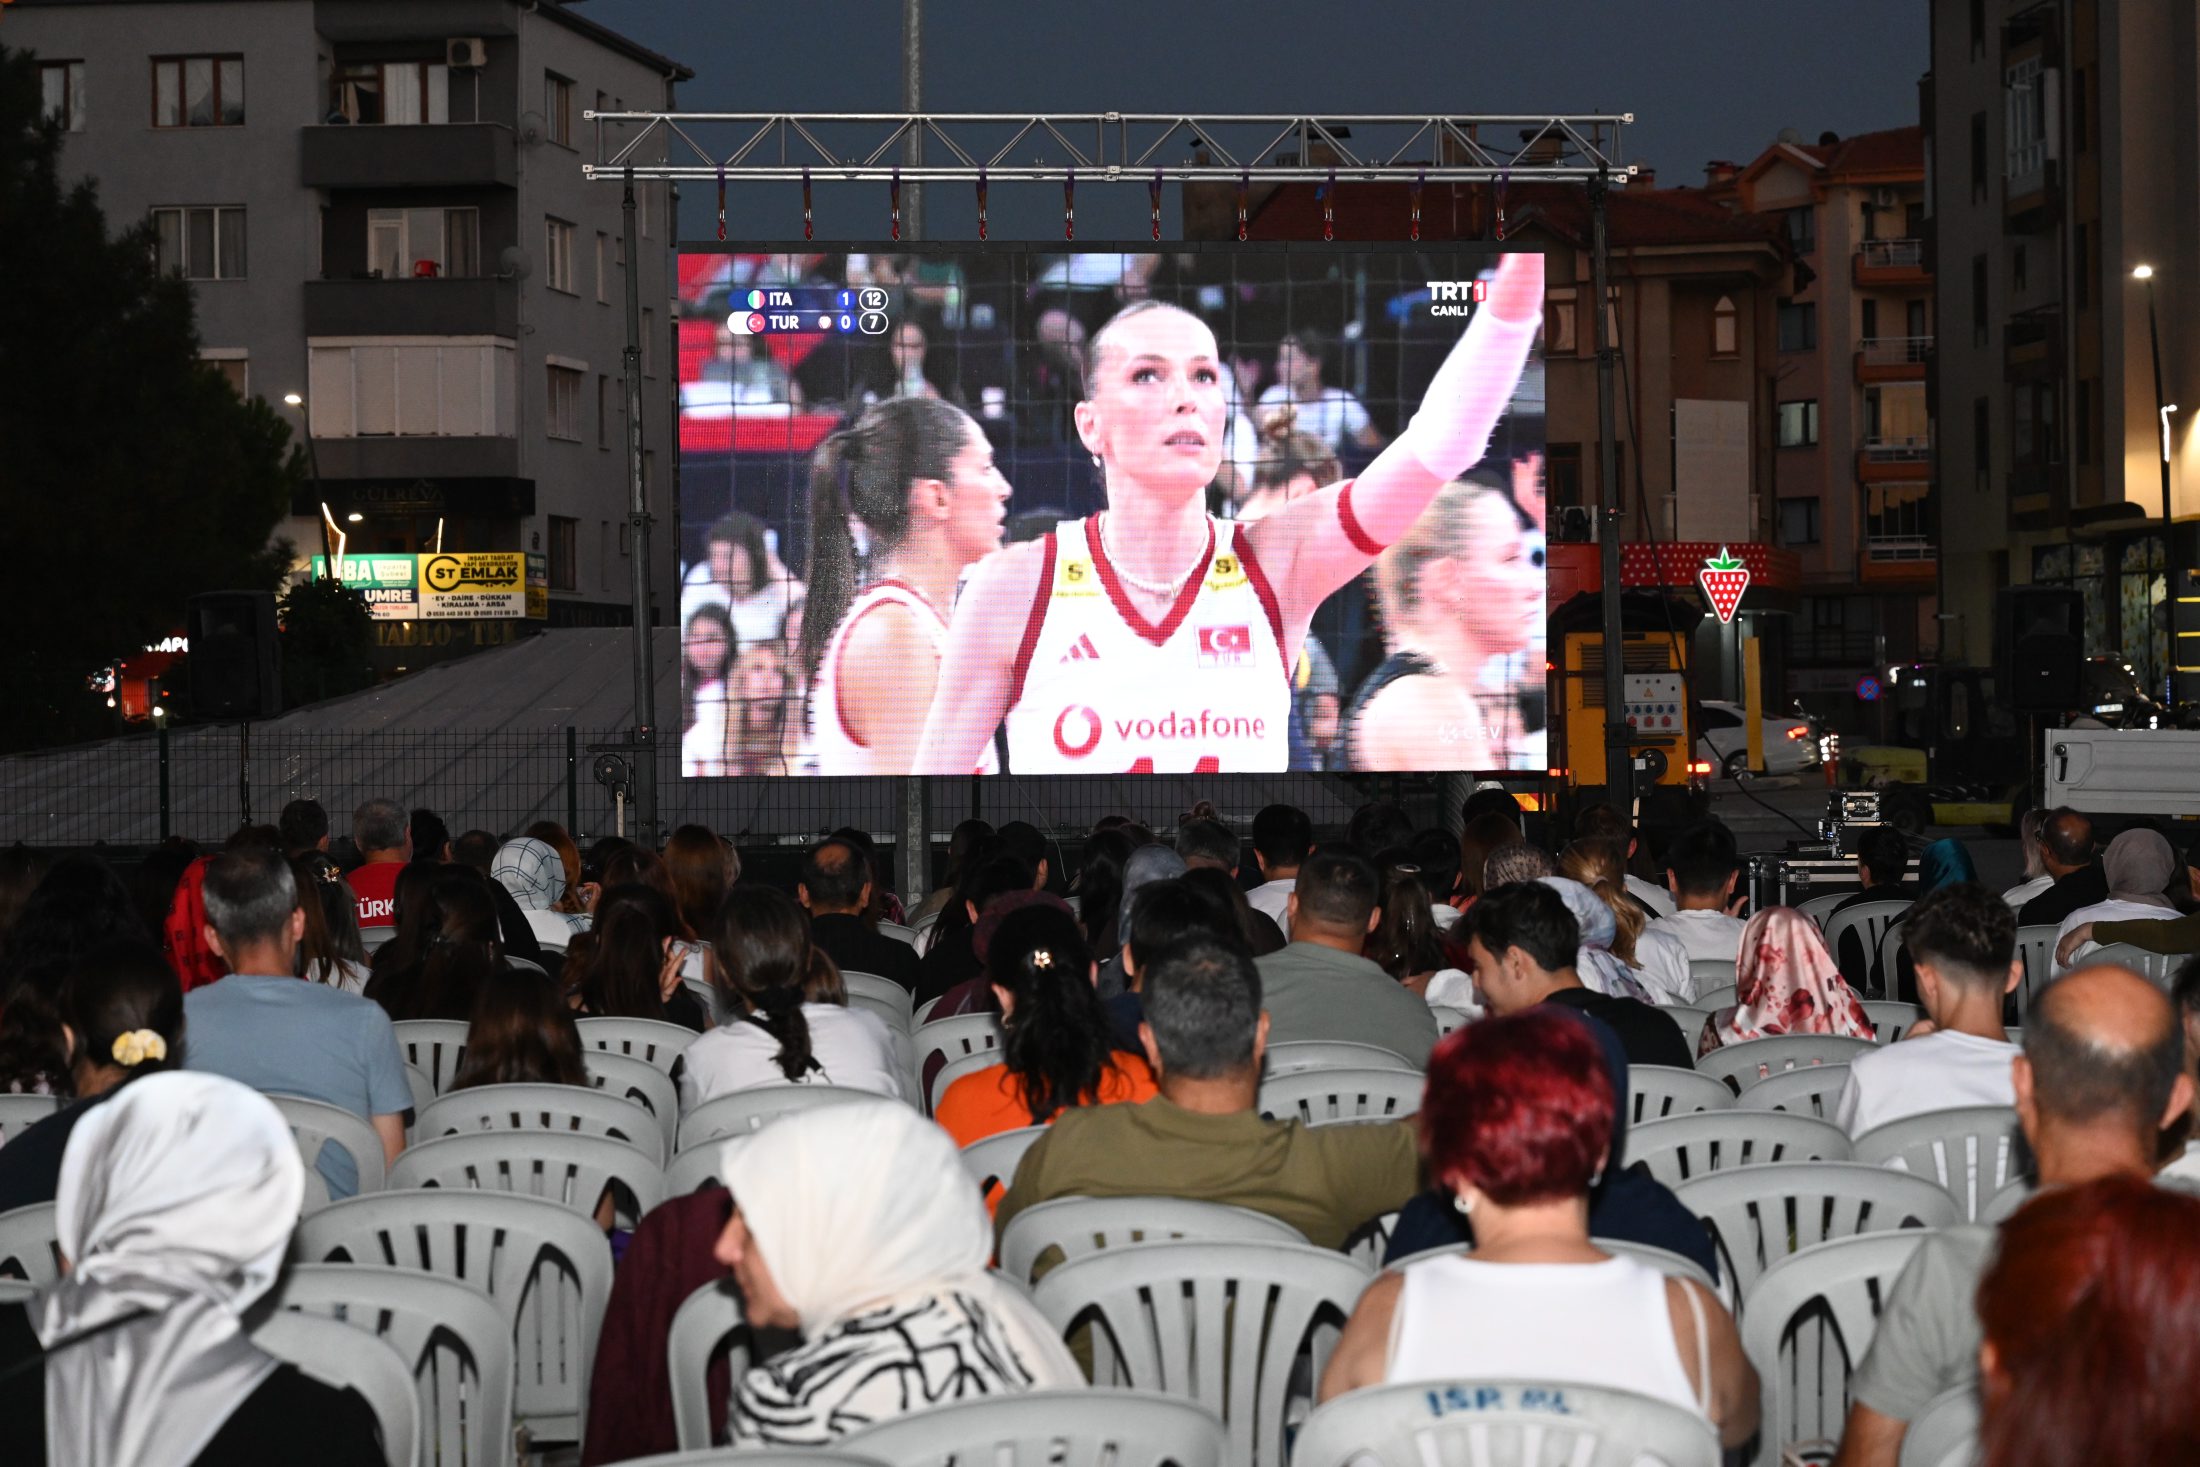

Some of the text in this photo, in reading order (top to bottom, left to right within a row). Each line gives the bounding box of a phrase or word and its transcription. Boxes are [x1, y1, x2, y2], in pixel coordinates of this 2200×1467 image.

[769, 292, 881, 306] ITA 1 12
[1430, 305, 1468, 316] CANLI
[769, 315, 878, 330] TUR 0 7
[436, 567, 518, 579] ST EMLAK
[1705, 572, 1744, 585] ÇİLEK
[364, 589, 412, 603] UMRE
[1114, 708, 1266, 741] vodafone
[356, 896, 394, 918] ÜRK
